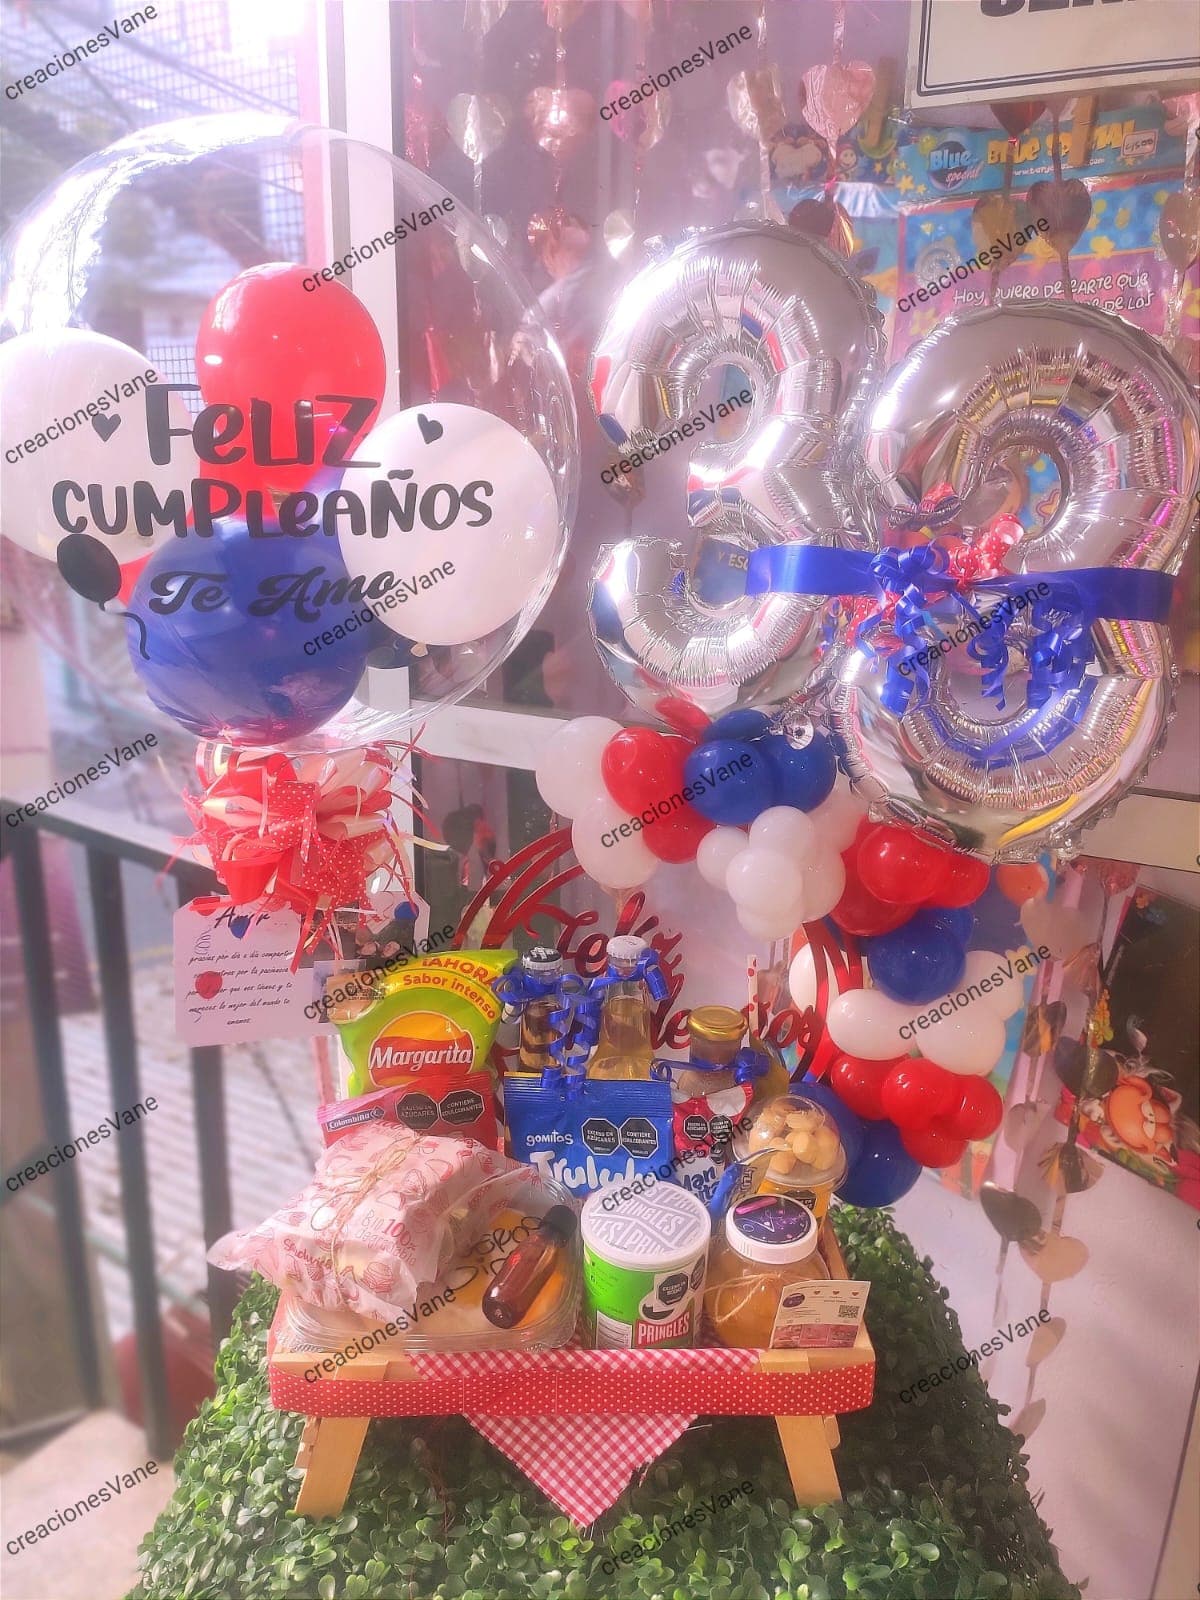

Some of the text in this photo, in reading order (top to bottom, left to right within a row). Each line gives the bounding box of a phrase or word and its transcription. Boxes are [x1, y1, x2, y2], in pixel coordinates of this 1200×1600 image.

[930, 149, 973, 170] Blue
[953, 289, 985, 306] Hoy
[148, 565, 402, 623] Te Amo
[403, 973, 496, 1021] Sabor intenso
[370, 1043, 474, 1072] Margarita
[328, 1112, 371, 1130] Colombina
[614, 1196, 684, 1236] RINGLES
[637, 1312, 690, 1345] PRINGLES
